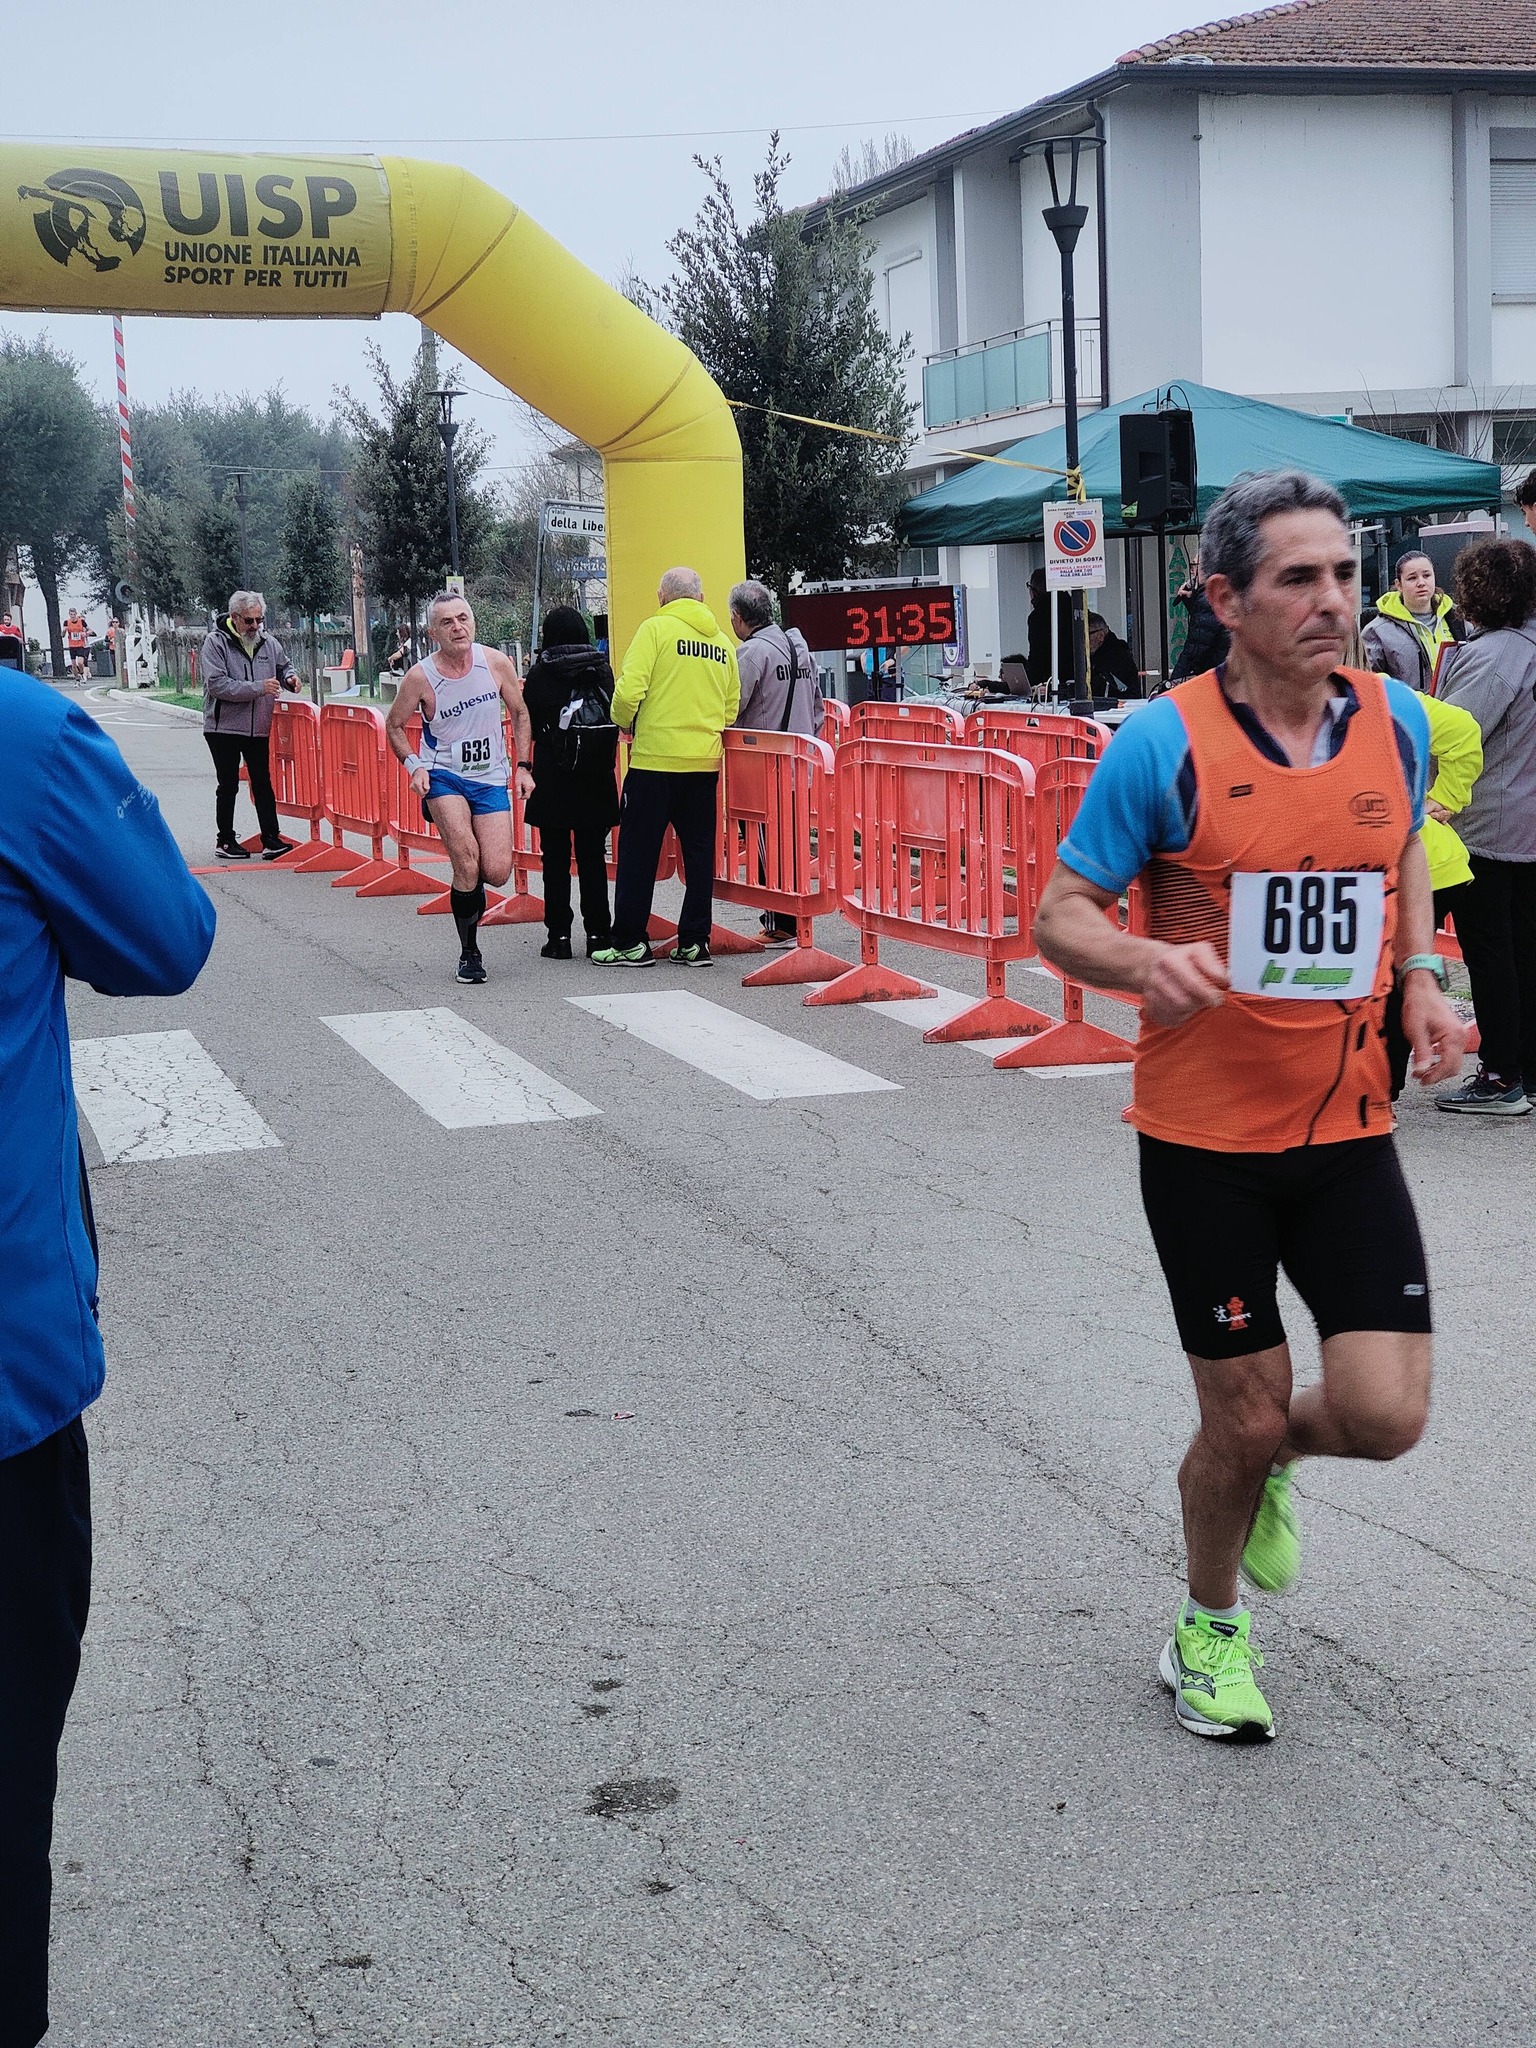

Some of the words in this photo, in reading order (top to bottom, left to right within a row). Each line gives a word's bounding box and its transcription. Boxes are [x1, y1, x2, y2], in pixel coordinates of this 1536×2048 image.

[158, 171, 357, 239] UISP
[165, 241, 251, 265] UNIONE
[263, 245, 361, 267] ITALIANA
[163, 265, 235, 286] SPORT
[244, 269, 282, 287] PER
[293, 270, 348, 288] TUTTI
[551, 516, 577, 530] della
[846, 602, 952, 645] 31:35
[677, 639, 727, 665] GIUDICE
[440, 691, 497, 720] lughesina
[461, 737, 491, 763] 633
[1264, 876, 1358, 955] 685
[1212, 1622, 1235, 1633] saucony
